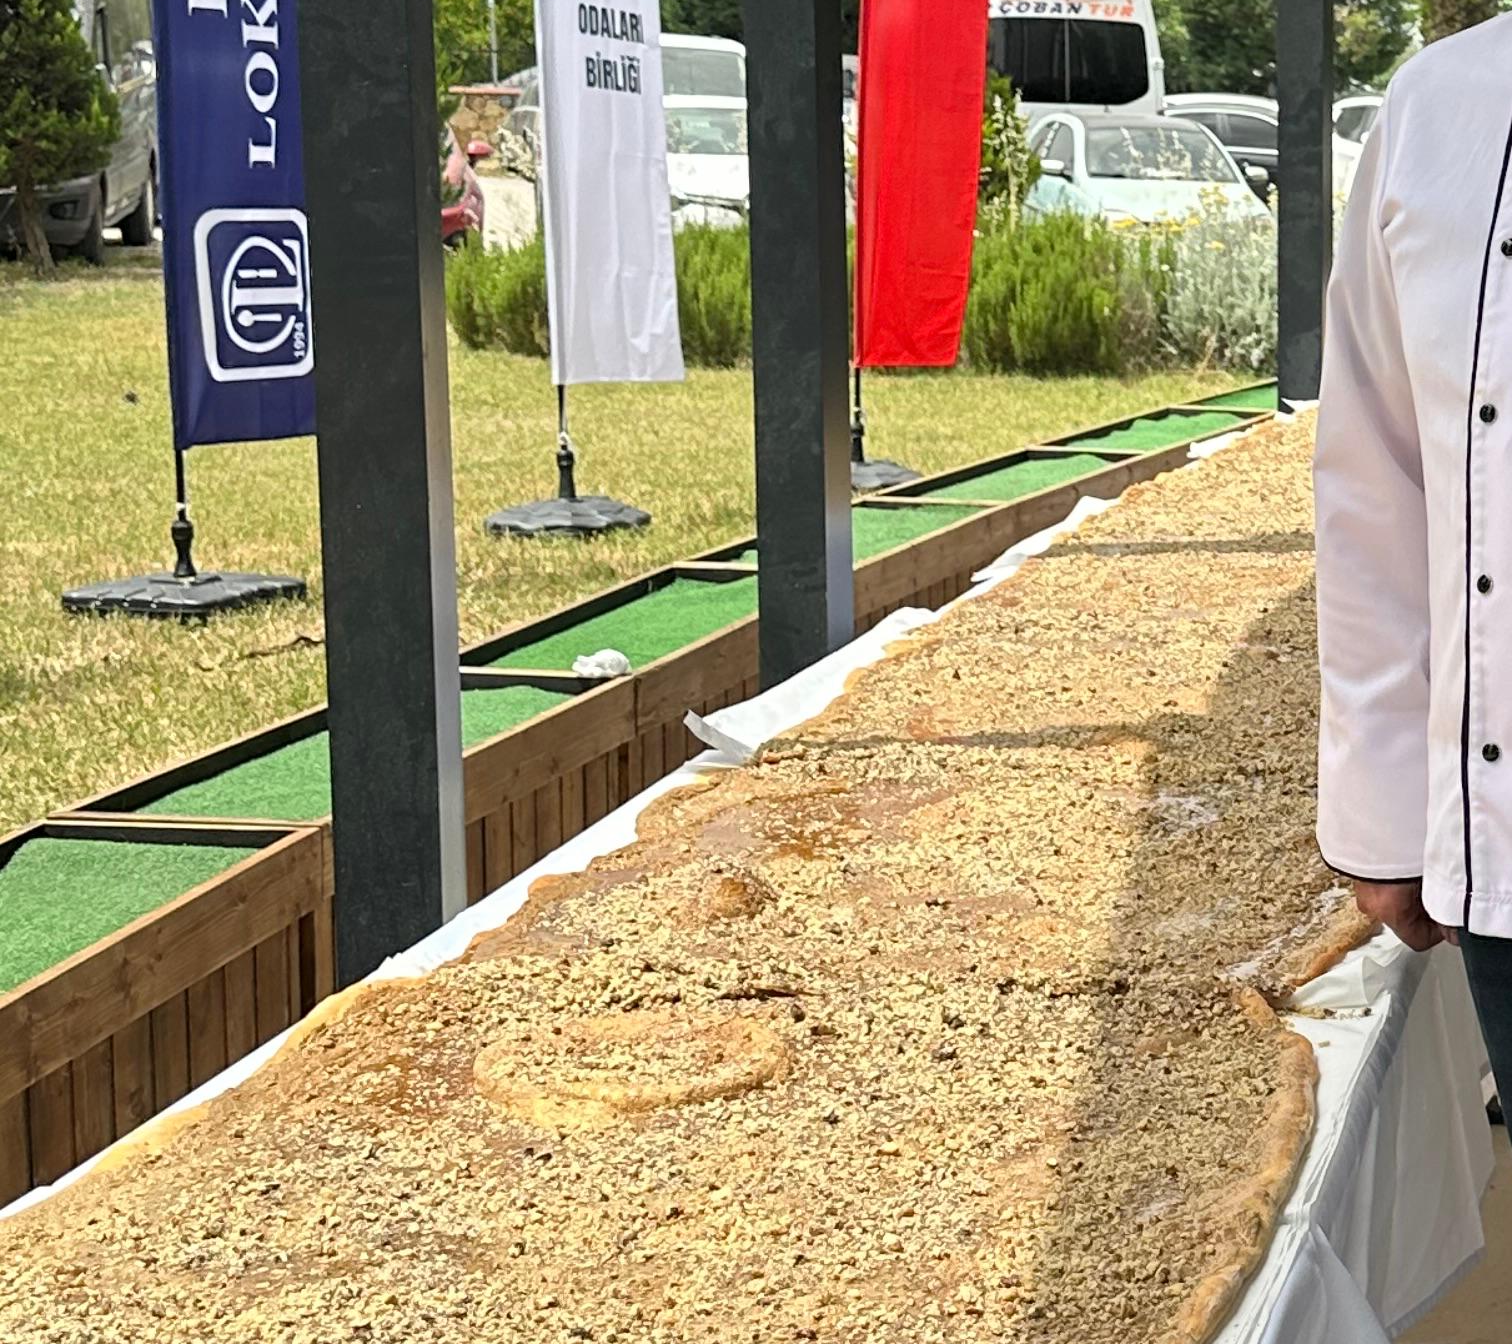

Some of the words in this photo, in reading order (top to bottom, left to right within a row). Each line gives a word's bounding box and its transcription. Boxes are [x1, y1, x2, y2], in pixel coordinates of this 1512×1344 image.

[578, 3, 644, 44] ODALARI
[1088, 1, 1136, 17] TUR
[585, 51, 641, 94] BİRLİĞİ
